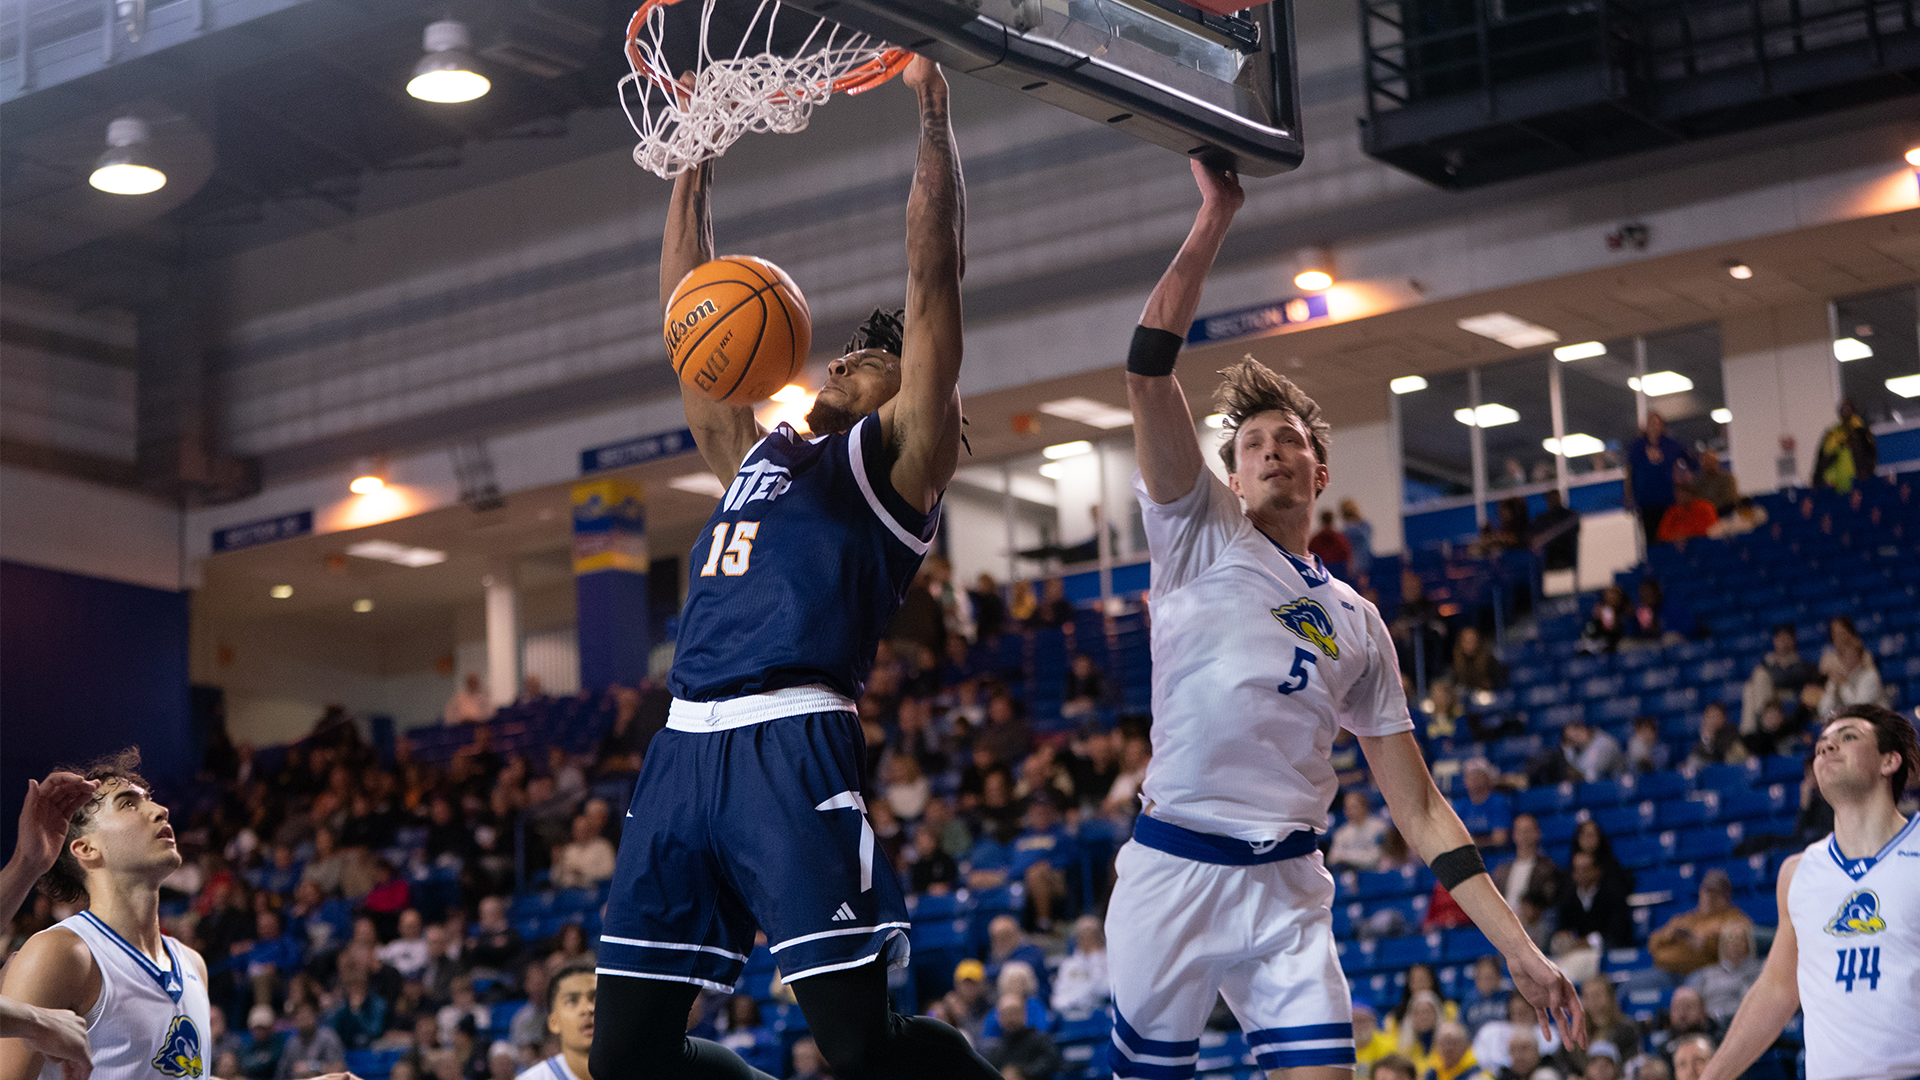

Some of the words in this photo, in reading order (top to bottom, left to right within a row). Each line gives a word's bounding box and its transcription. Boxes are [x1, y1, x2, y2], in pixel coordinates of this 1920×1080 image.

[694, 346, 730, 393] EVO
[722, 457, 793, 514] UTEP
[700, 520, 761, 578] 15
[1277, 645, 1318, 696] 5
[1835, 945, 1881, 994] 44
